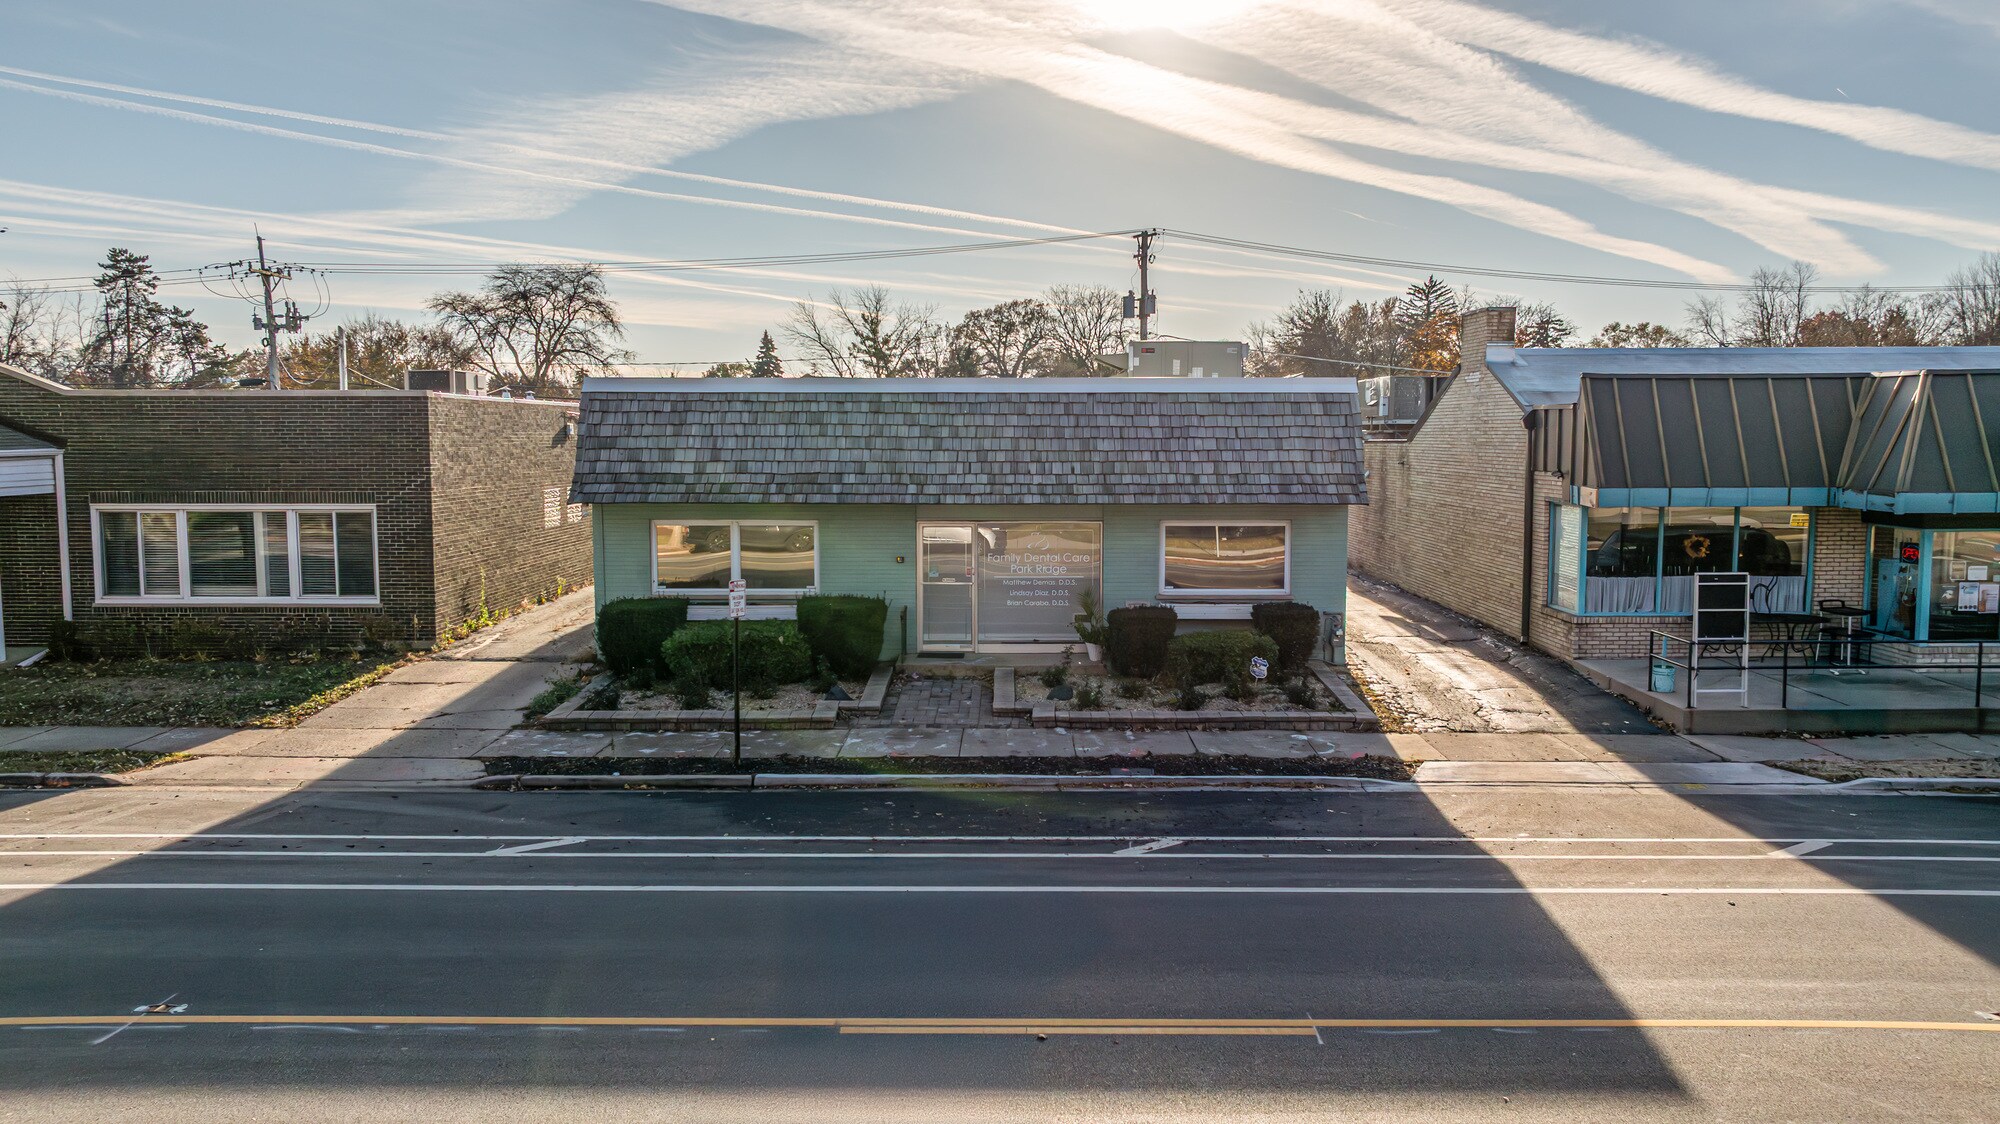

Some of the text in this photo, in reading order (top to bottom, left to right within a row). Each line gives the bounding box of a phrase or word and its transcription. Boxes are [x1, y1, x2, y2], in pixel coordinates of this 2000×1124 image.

[988, 553, 1090, 563] Family Dental Care
[1011, 564, 1067, 575] Park Ridge
